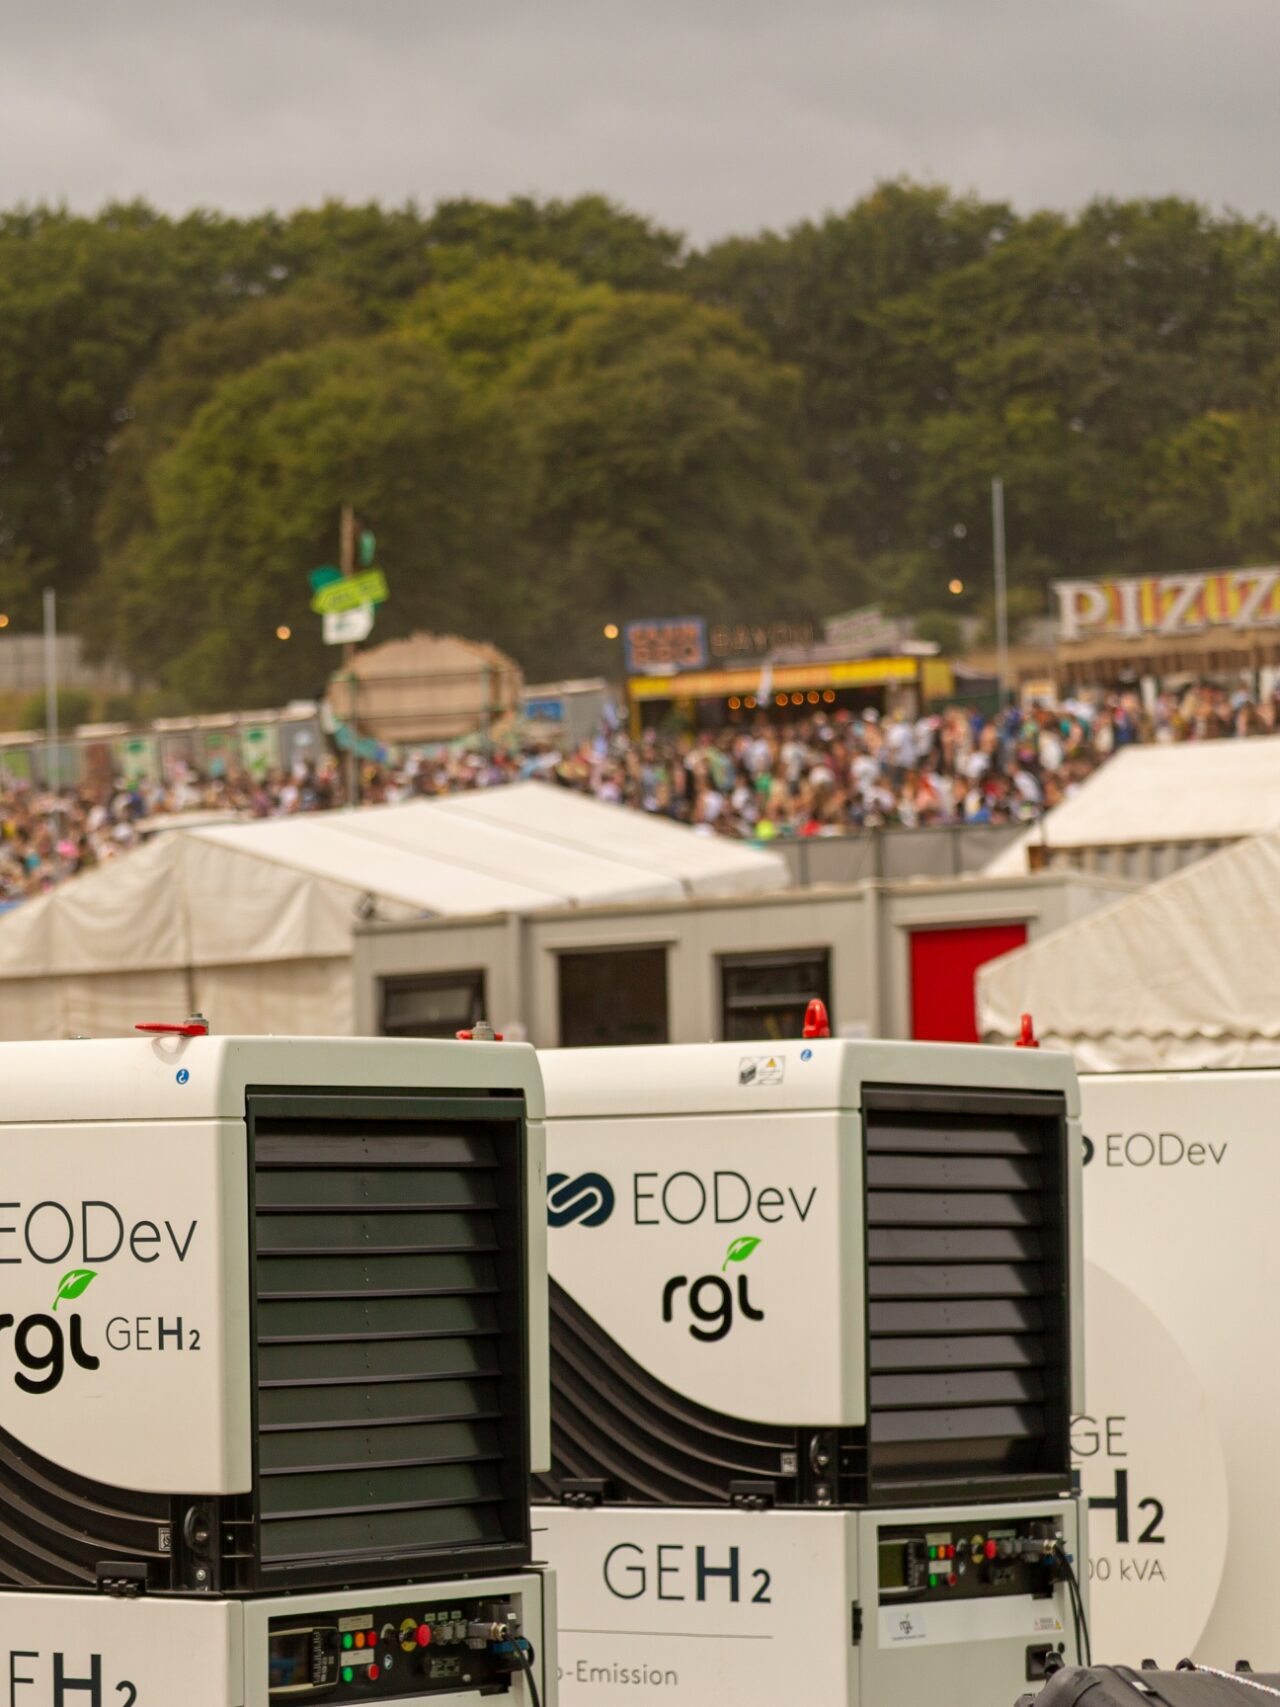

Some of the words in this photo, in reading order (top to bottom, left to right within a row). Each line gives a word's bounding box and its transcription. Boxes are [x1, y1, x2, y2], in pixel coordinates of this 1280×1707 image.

[1107, 1132, 1228, 1167] EODev
[634, 1171, 817, 1226] EODev
[663, 1273, 765, 1342] rgl
[105, 1316, 201, 1351] GEH2
[1070, 1415, 1128, 1457] GE
[603, 1542, 772, 1604] GEH2
[1120, 1558, 1166, 1582] kVA
